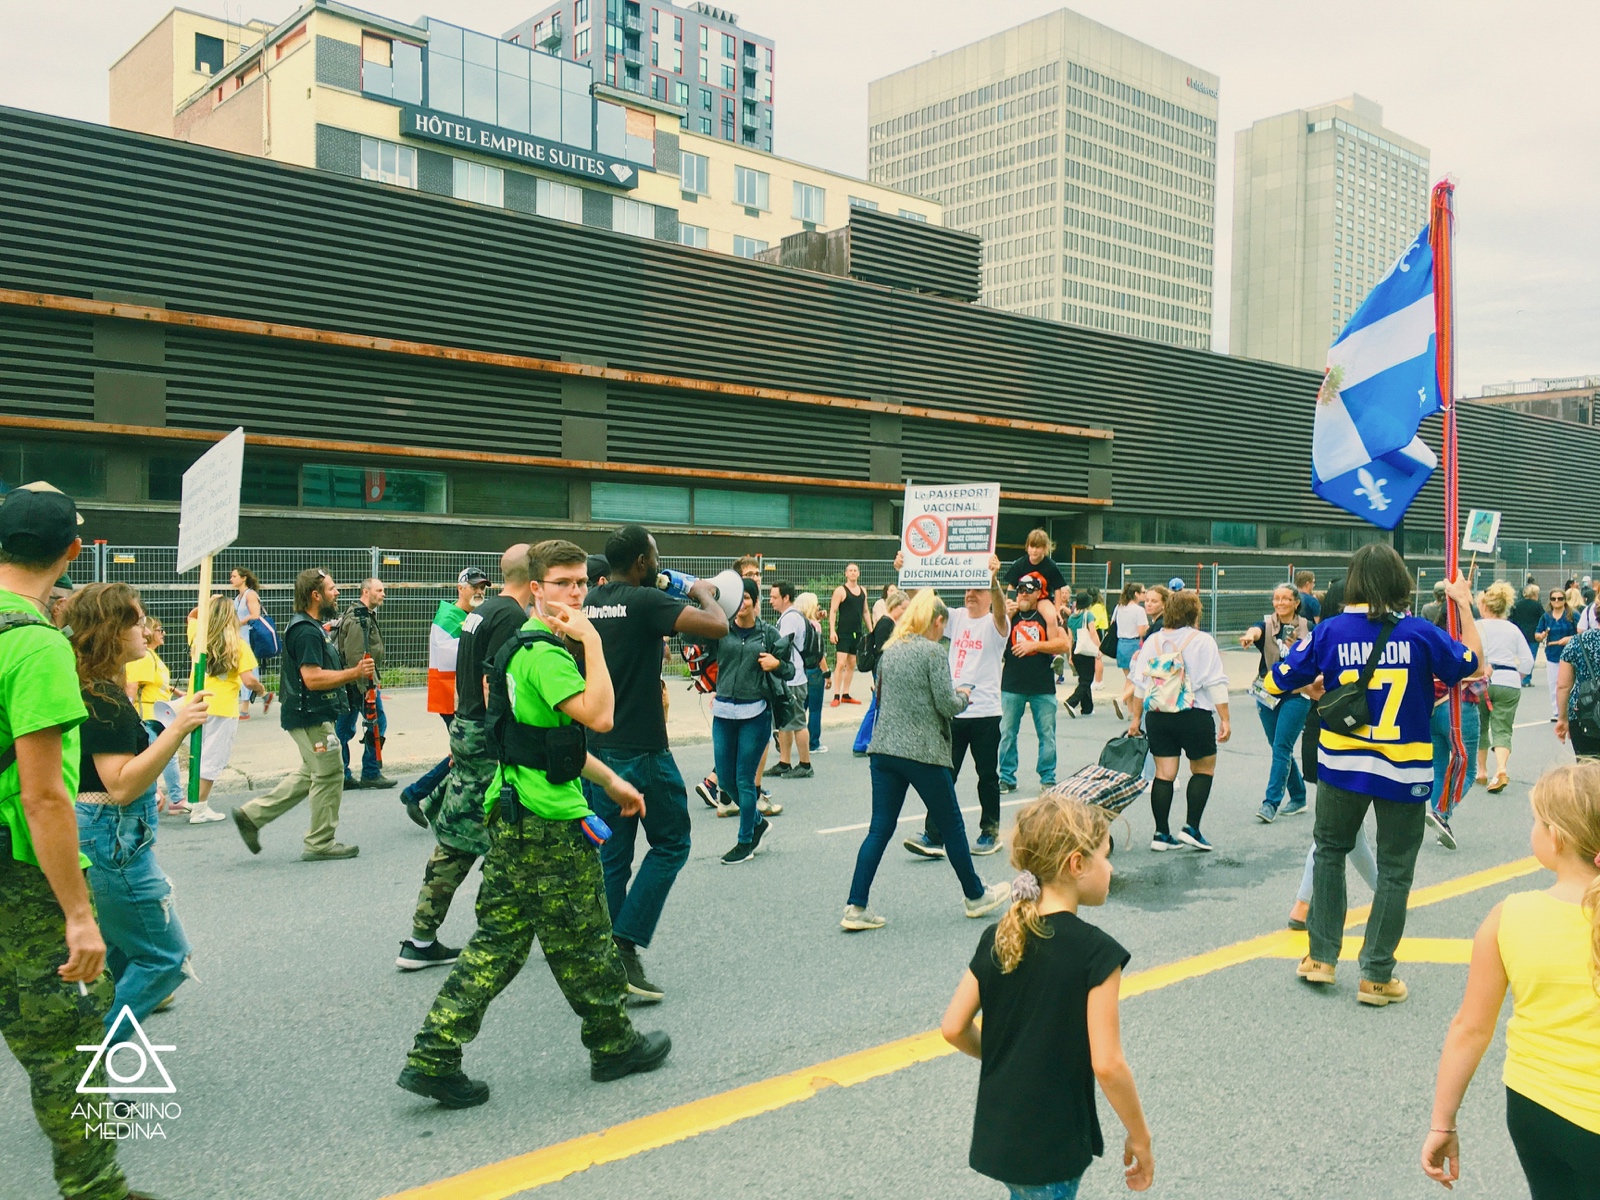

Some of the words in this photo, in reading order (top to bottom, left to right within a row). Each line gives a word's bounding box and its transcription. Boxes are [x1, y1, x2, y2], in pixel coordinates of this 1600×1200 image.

[415, 113, 476, 145] HÔTEL
[480, 130, 545, 161] EMPIRE
[549, 148, 605, 176] SUITES
[929, 488, 990, 499] PASSEPORT
[923, 502, 978, 513] VACCINAL
[920, 555, 961, 566] ILLÉGAL
[962, 557, 973, 566] et
[903, 569, 988, 579] DISCRIMINATOIRE
